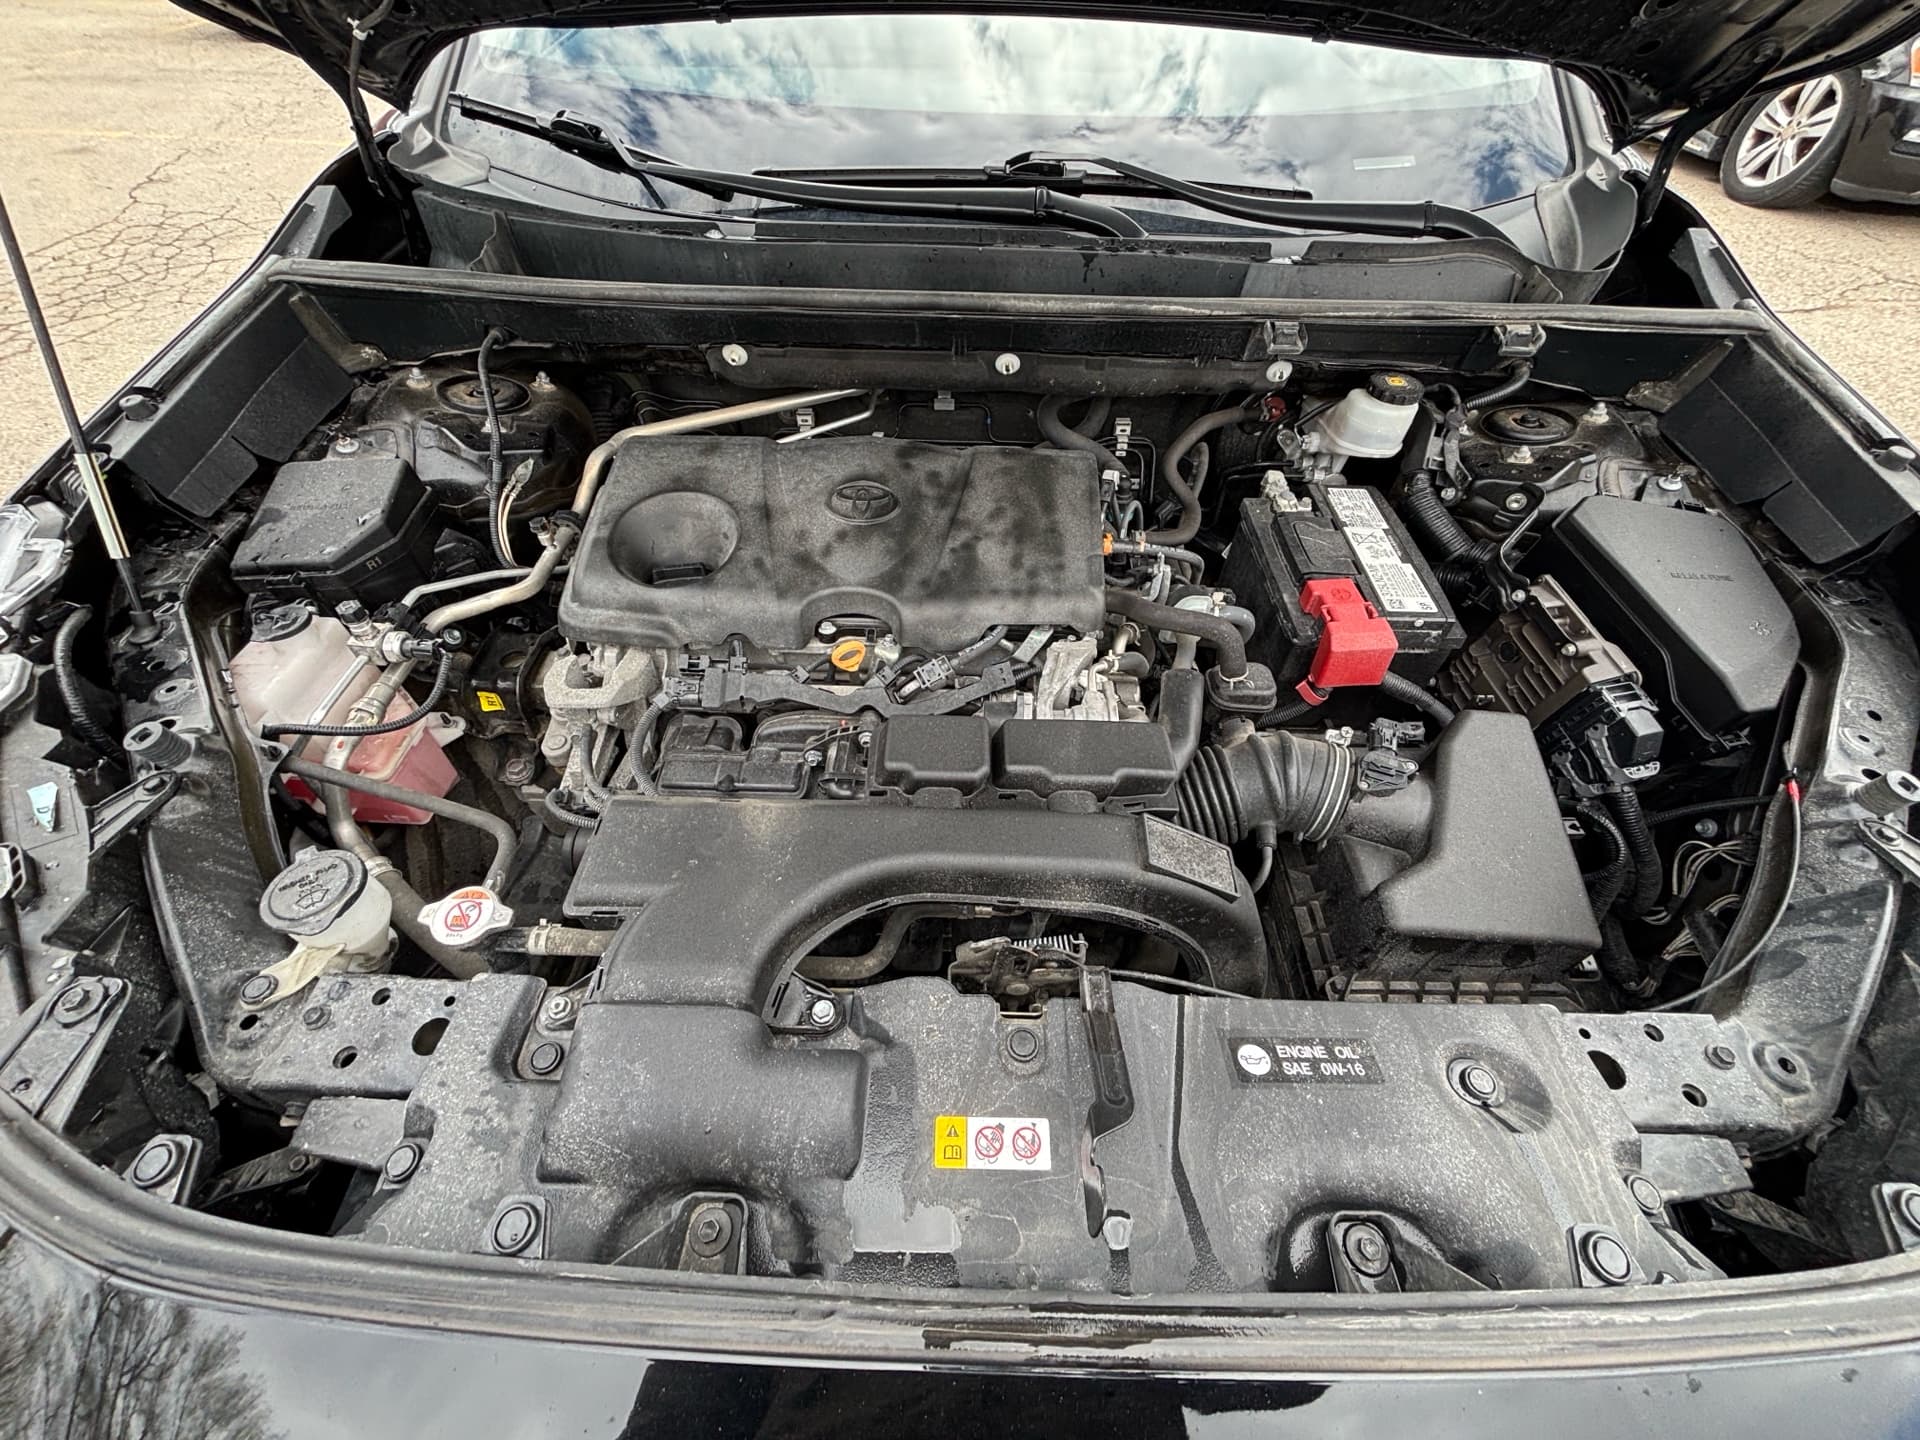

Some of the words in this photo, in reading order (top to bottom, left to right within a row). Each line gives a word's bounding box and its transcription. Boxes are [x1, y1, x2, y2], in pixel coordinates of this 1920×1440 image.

[366, 557, 382, 570] R1
[1275, 1045, 1329, 1059] ENGINE
[1334, 1046, 1360, 1059] OIL
[1281, 1062, 1313, 1075] SAE
[1320, 1062, 1366, 1076] 0W-16
